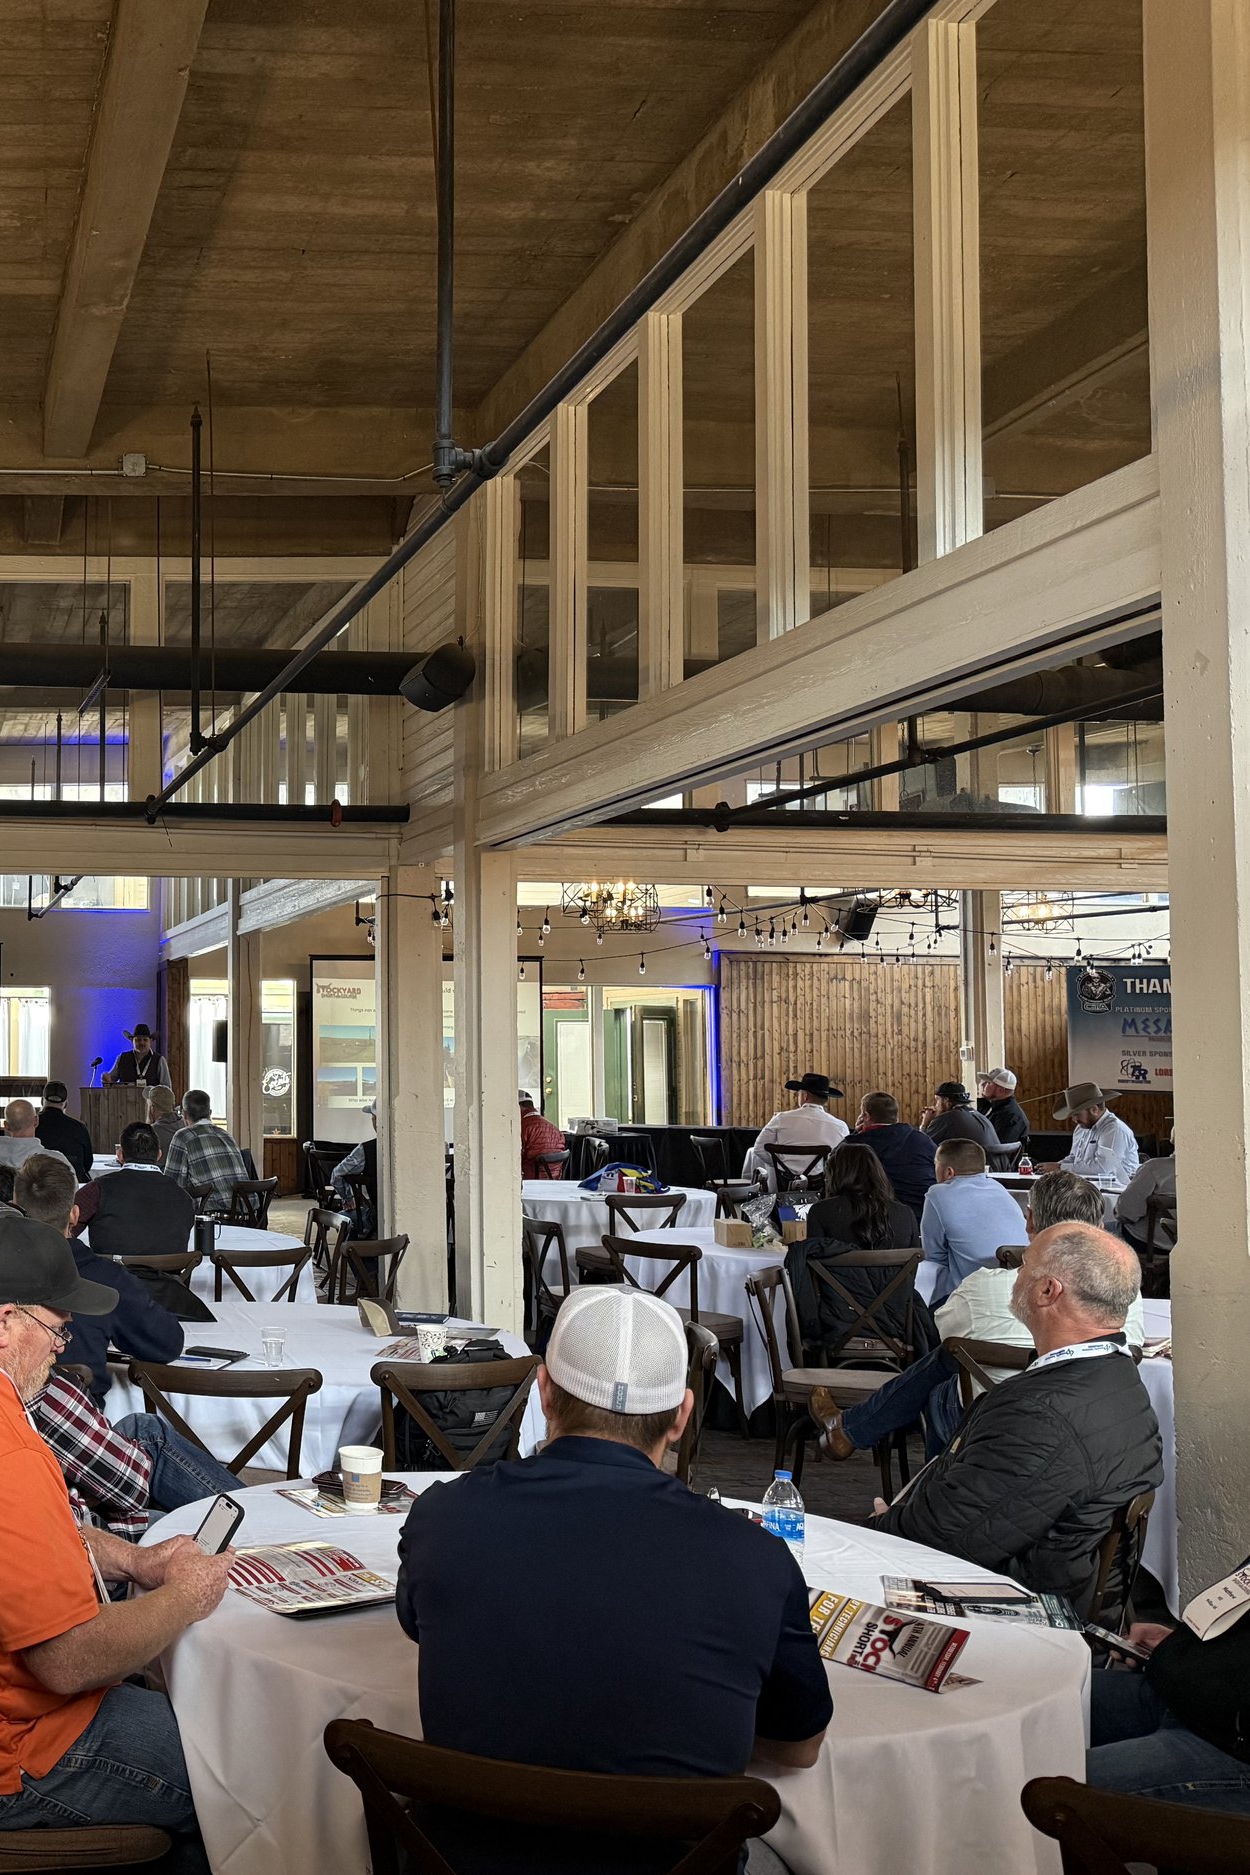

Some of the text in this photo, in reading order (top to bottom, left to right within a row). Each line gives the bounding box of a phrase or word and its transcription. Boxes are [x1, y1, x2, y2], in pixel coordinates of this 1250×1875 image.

[1115, 1006, 1153, 1014] PLATINUM
[817, 1594, 839, 1616] FOR
[820, 1599, 861, 1658] BY TECHNICIANS
[853, 1621, 879, 1658] SHORT
[900, 1621, 925, 1659] 4TH ANNUAL
